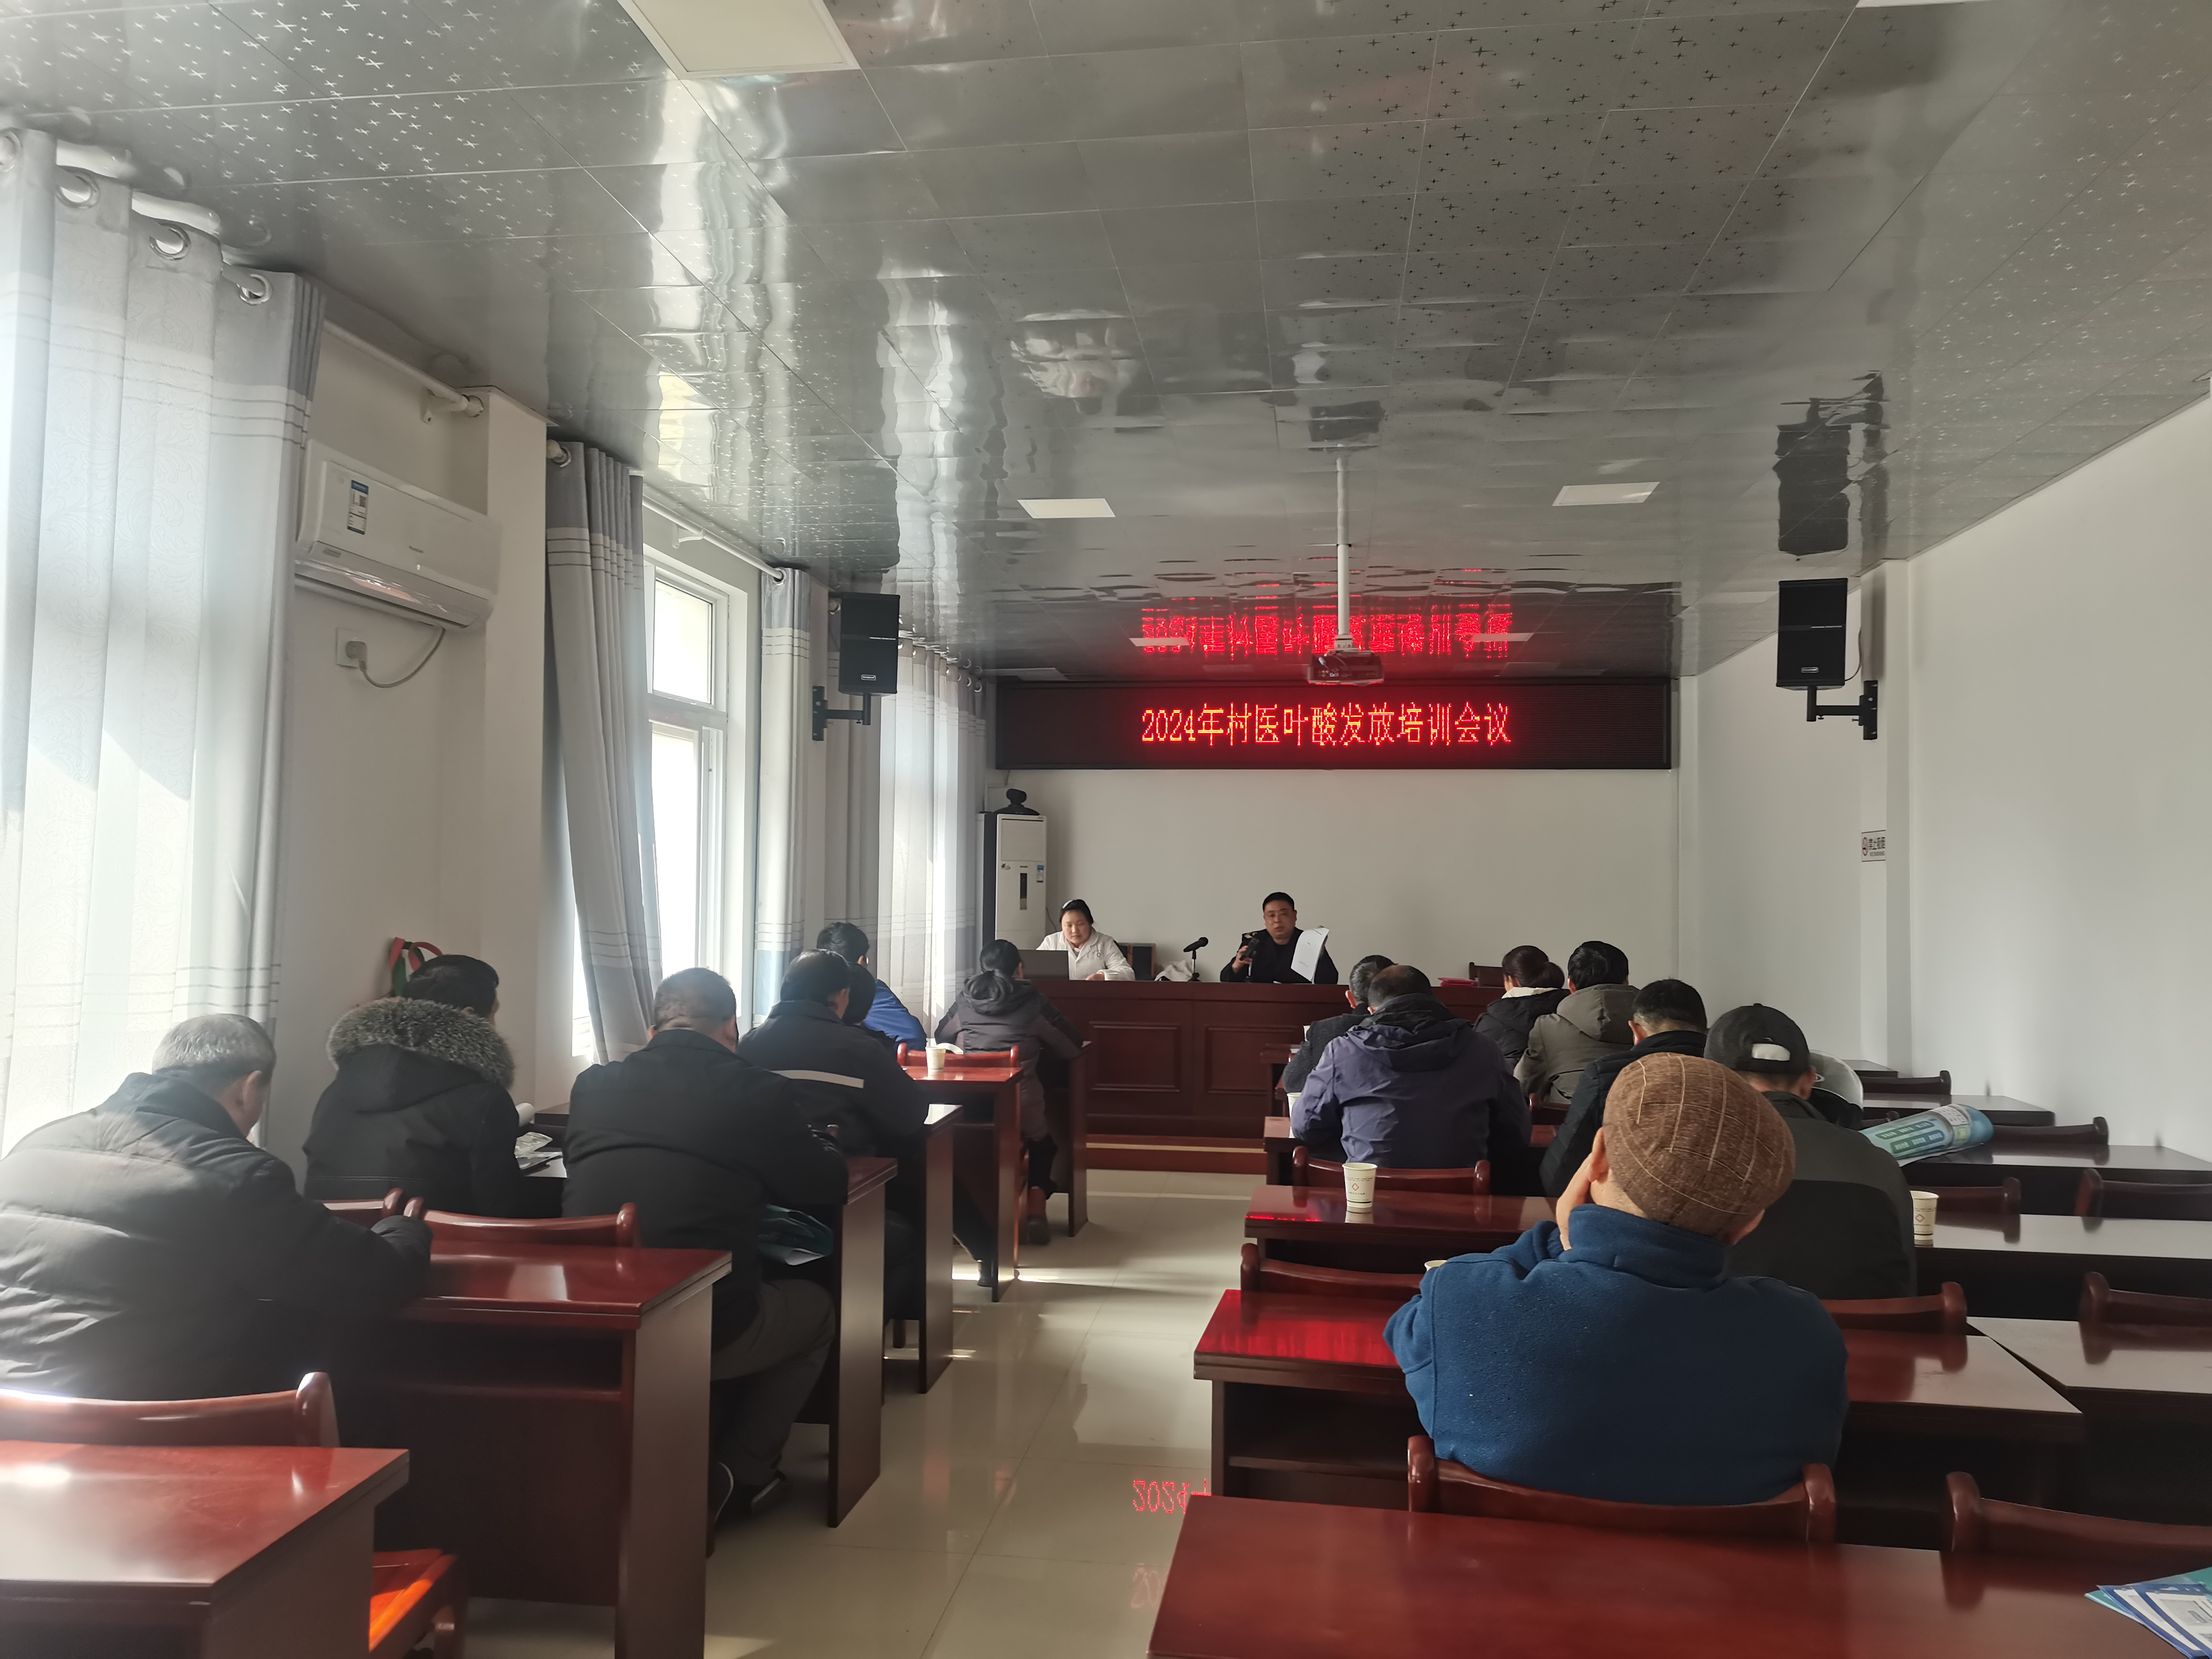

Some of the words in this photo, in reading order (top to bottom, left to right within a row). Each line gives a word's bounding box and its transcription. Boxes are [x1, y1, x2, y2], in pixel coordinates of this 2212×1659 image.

[1141, 701, 1512, 747] 2024年村医叶酸发放培训会议
